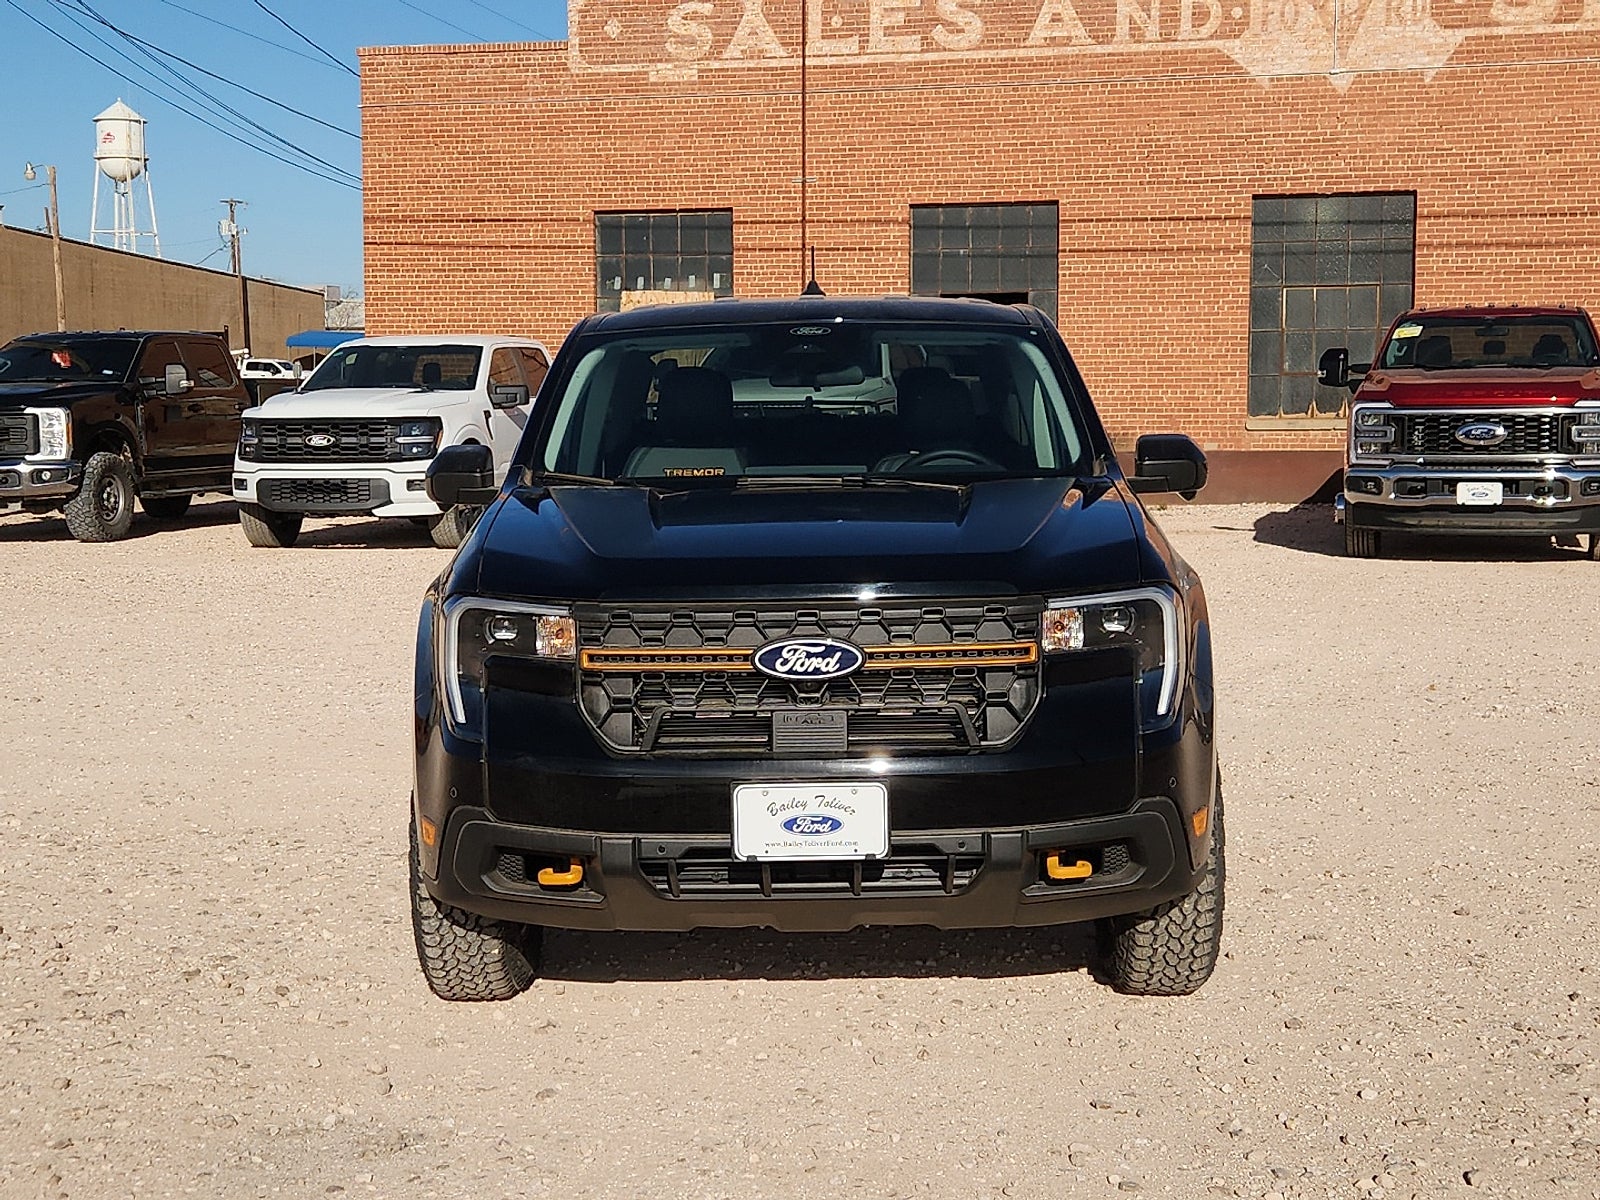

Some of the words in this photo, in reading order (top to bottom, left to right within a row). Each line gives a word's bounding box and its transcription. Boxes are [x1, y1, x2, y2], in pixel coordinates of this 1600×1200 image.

[664, 0, 984, 60] SALES
[1020, 0, 1223, 48] AND
[664, 468, 725, 477] TREMOR
[775, 645, 842, 673] Ford
[766, 796, 808, 817] Bailey
[814, 794, 856, 816] Toliver
[792, 816, 833, 833] Ford
